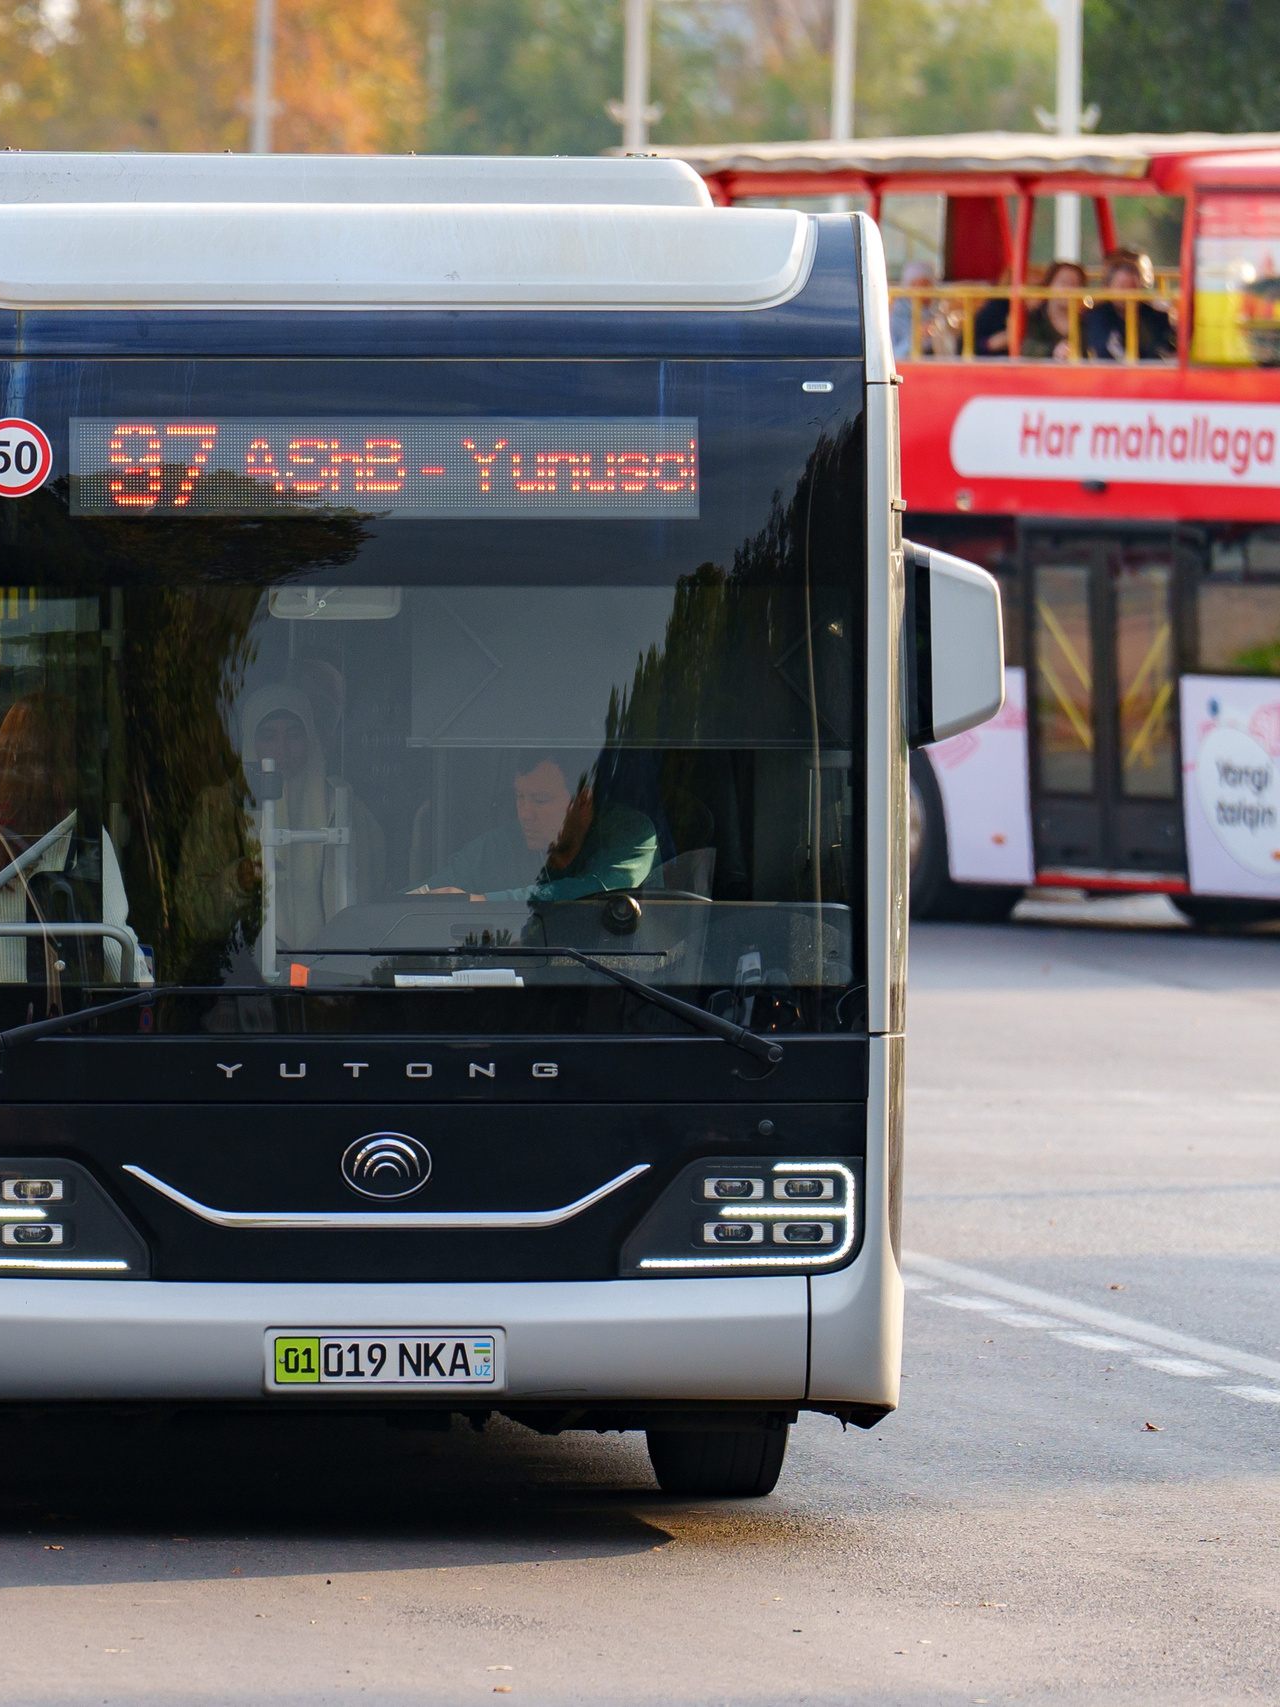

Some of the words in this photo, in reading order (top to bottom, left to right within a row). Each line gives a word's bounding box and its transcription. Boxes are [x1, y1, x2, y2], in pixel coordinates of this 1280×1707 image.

[1020, 410, 1081, 459] Har
[1089, 412, 1276, 475] mahallaga
[110, 426, 217, 505] 97
[462, 439, 695, 491] Yunuso
[216, 1062, 559, 1078] YUTONG
[284, 1347, 315, 1374] 01
[323, 1342, 388, 1377] 019
[398, 1342, 472, 1377] NKA
[474, 1364, 491, 1376] UZ
